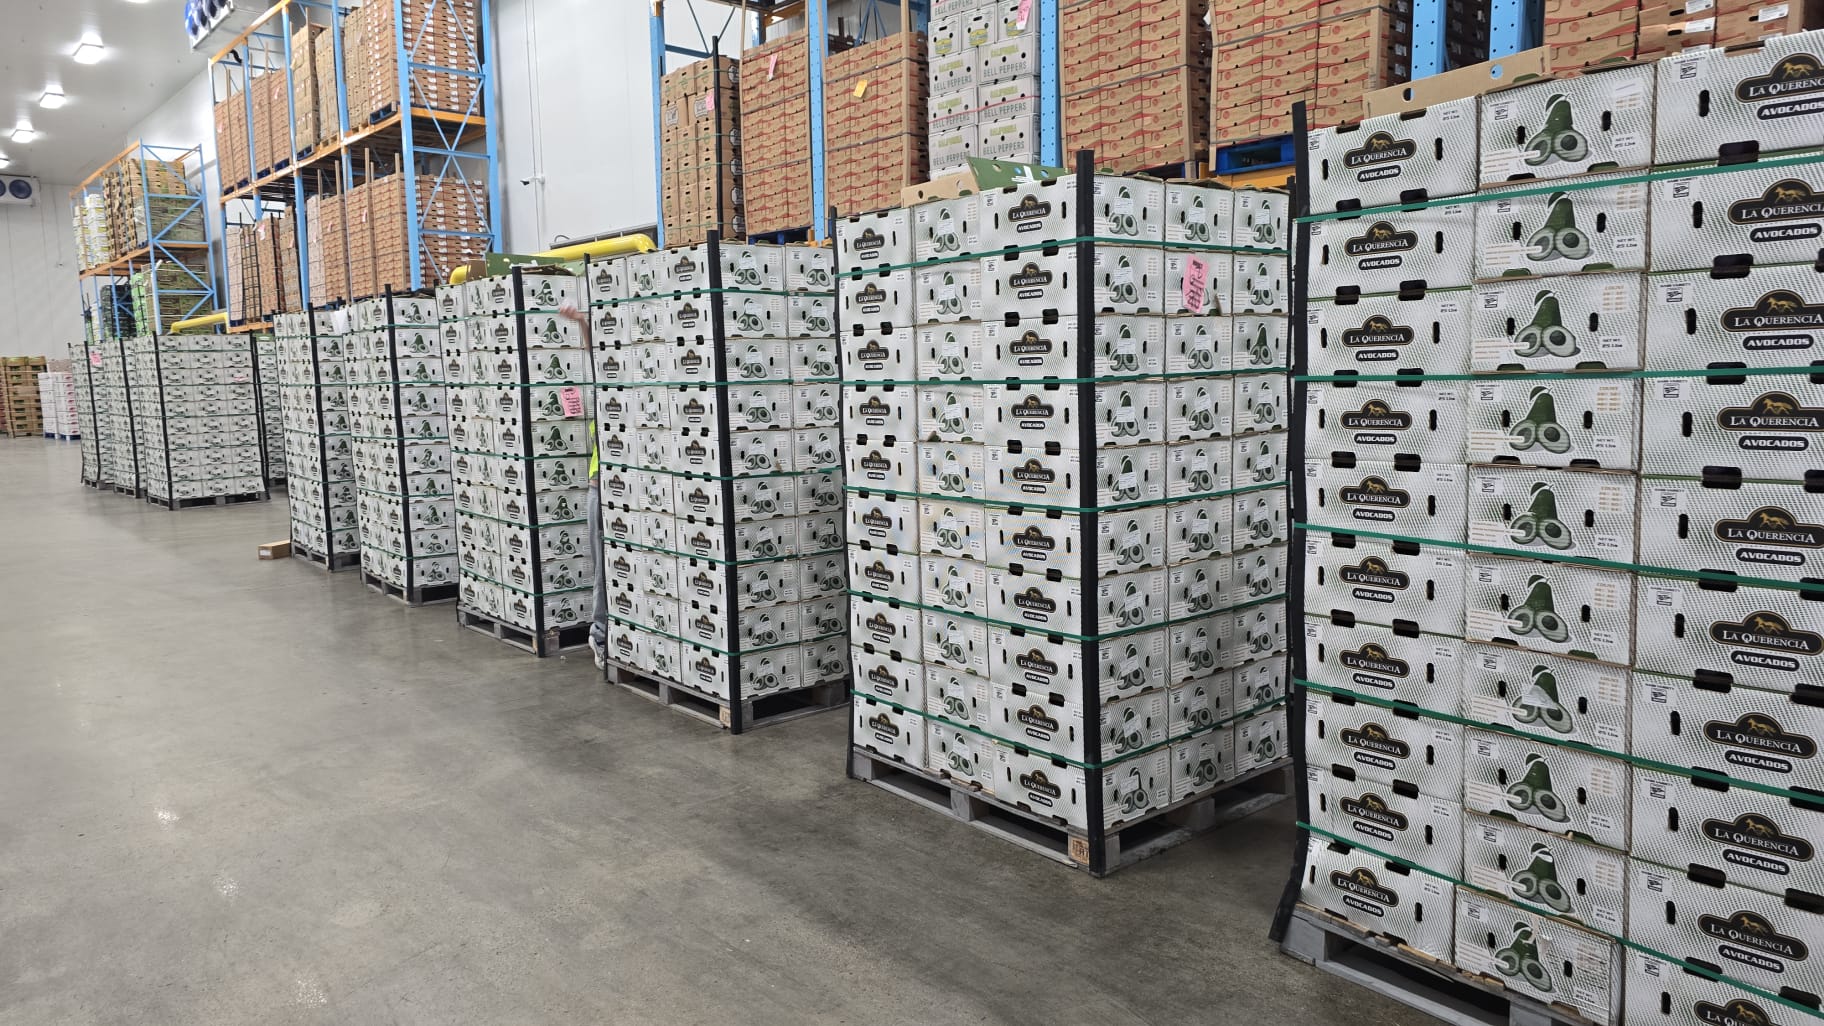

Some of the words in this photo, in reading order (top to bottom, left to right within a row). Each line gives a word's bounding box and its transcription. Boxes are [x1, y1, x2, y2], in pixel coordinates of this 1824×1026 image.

[984, 67, 997, 77] BELL
[1000, 61, 1027, 73] PEPPERS
[947, 75, 972, 88] PEPPERS
[1749, 87, 1765, 96] LA
[984, 109, 997, 118] BELL
[1000, 103, 1026, 115] PEPPERS
[1761, 101, 1824, 116] AVOCADOS
[946, 114, 970, 125] PEPPERS
[983, 146, 996, 155] BELL
[998, 141, 1024, 151] PEPPERS
[1351, 153, 1362, 164] LA
[1363, 148, 1407, 163] QUERENCIA
[1359, 167, 1399, 179] AVOCADOS
[1742, 210, 1757, 219] LA
[1754, 227, 1817, 238] AVOCADOS
[1353, 243, 1363, 252] LA
[1365, 239, 1408, 251] QUERENCIA
[1361, 258, 1400, 267] AVOCADOS
[1735, 317, 1750, 327] LA
[1754, 314, 1824, 326] QUERENCIA
[1361, 334, 1404, 343] QUERENCIA
[1747, 338, 1810, 346] AVOCADOS
[1349, 418, 1358, 426] LA
[1360, 418, 1403, 427] QUERENCIA
[1730, 417, 1746, 426] LA
[1750, 417, 1819, 427] QUERENCIA
[1743, 439, 1804, 447] AVOCADOS
[1347, 493, 1358, 501] LA
[1359, 494, 1400, 504] QUERENCIA
[1355, 511, 1393, 519] AVOCADOS
[1728, 528, 1743, 538] LA
[1747, 530, 1816, 543] QUERENCIA
[1740, 552, 1801, 562] AVOCADOS
[1347, 572, 1357, 580] LA
[1359, 574, 1400, 586] QUERENCIA
[1355, 591, 1393, 600] AVOCADOS
[1723, 631, 1737, 640] LA
[1742, 633, 1809, 650] QUERENCIA
[1348, 657, 1357, 665] LA
[1359, 659, 1400, 673] QUERENCIA
[1735, 654, 1796, 668] AVOCADOS
[1355, 676, 1393, 687] AVOCADOS
[1349, 736, 1358, 744] LA
[1360, 739, 1401, 754] QUERENCIA
[1717, 730, 1732, 740] LA
[1735, 734, 1802, 753] QUERENCIA
[1356, 755, 1393, 768] AVOCADOS
[1729, 754, 1788, 769] AVOCADOS
[1359, 808, 1399, 826] QUERENCIA
[1356, 823, 1392, 839] AVOCADOS
[1715, 828, 1729, 839] LA
[1733, 833, 1799, 856] QUERENCIA
[1727, 853, 1785, 872] AVOCADOS
[1338, 878, 1347, 886] LA
[1349, 883, 1390, 902] QUERENCIA
[1346, 898, 1382, 915] AVOCADOS
[1711, 924, 1725, 935] LA
[1729, 930, 1793, 955] QUERENCIA
[1722, 949, 1780, 970] AVOCADOS
[1707, 1011, 1720, 1022] LA
